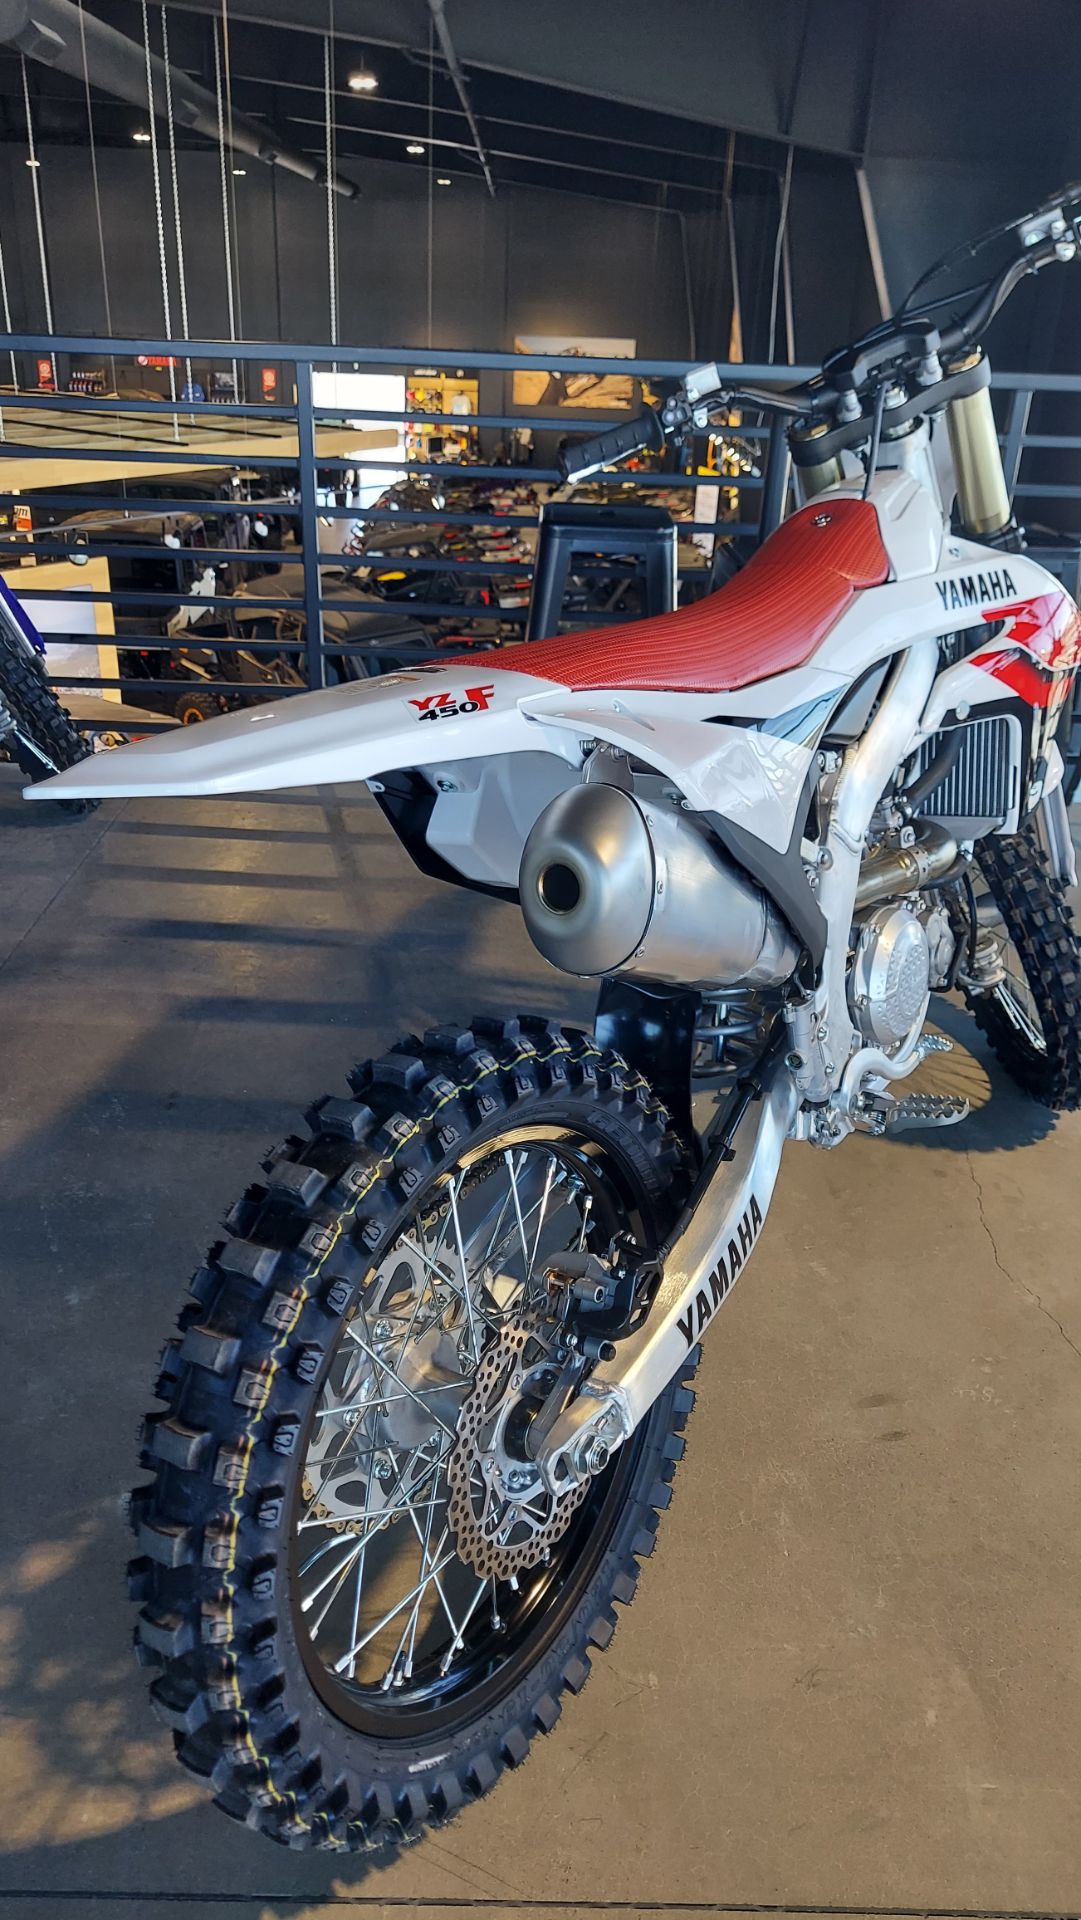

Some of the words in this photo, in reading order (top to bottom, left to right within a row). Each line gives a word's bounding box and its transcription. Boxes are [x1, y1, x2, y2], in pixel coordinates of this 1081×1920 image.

[935, 568, 1018, 611] YAMAHA
[408, 692, 457, 711] YZ
[464, 684, 495, 712] F
[418, 701, 479, 721] 450
[676, 1193, 763, 1349] YAMAHA
